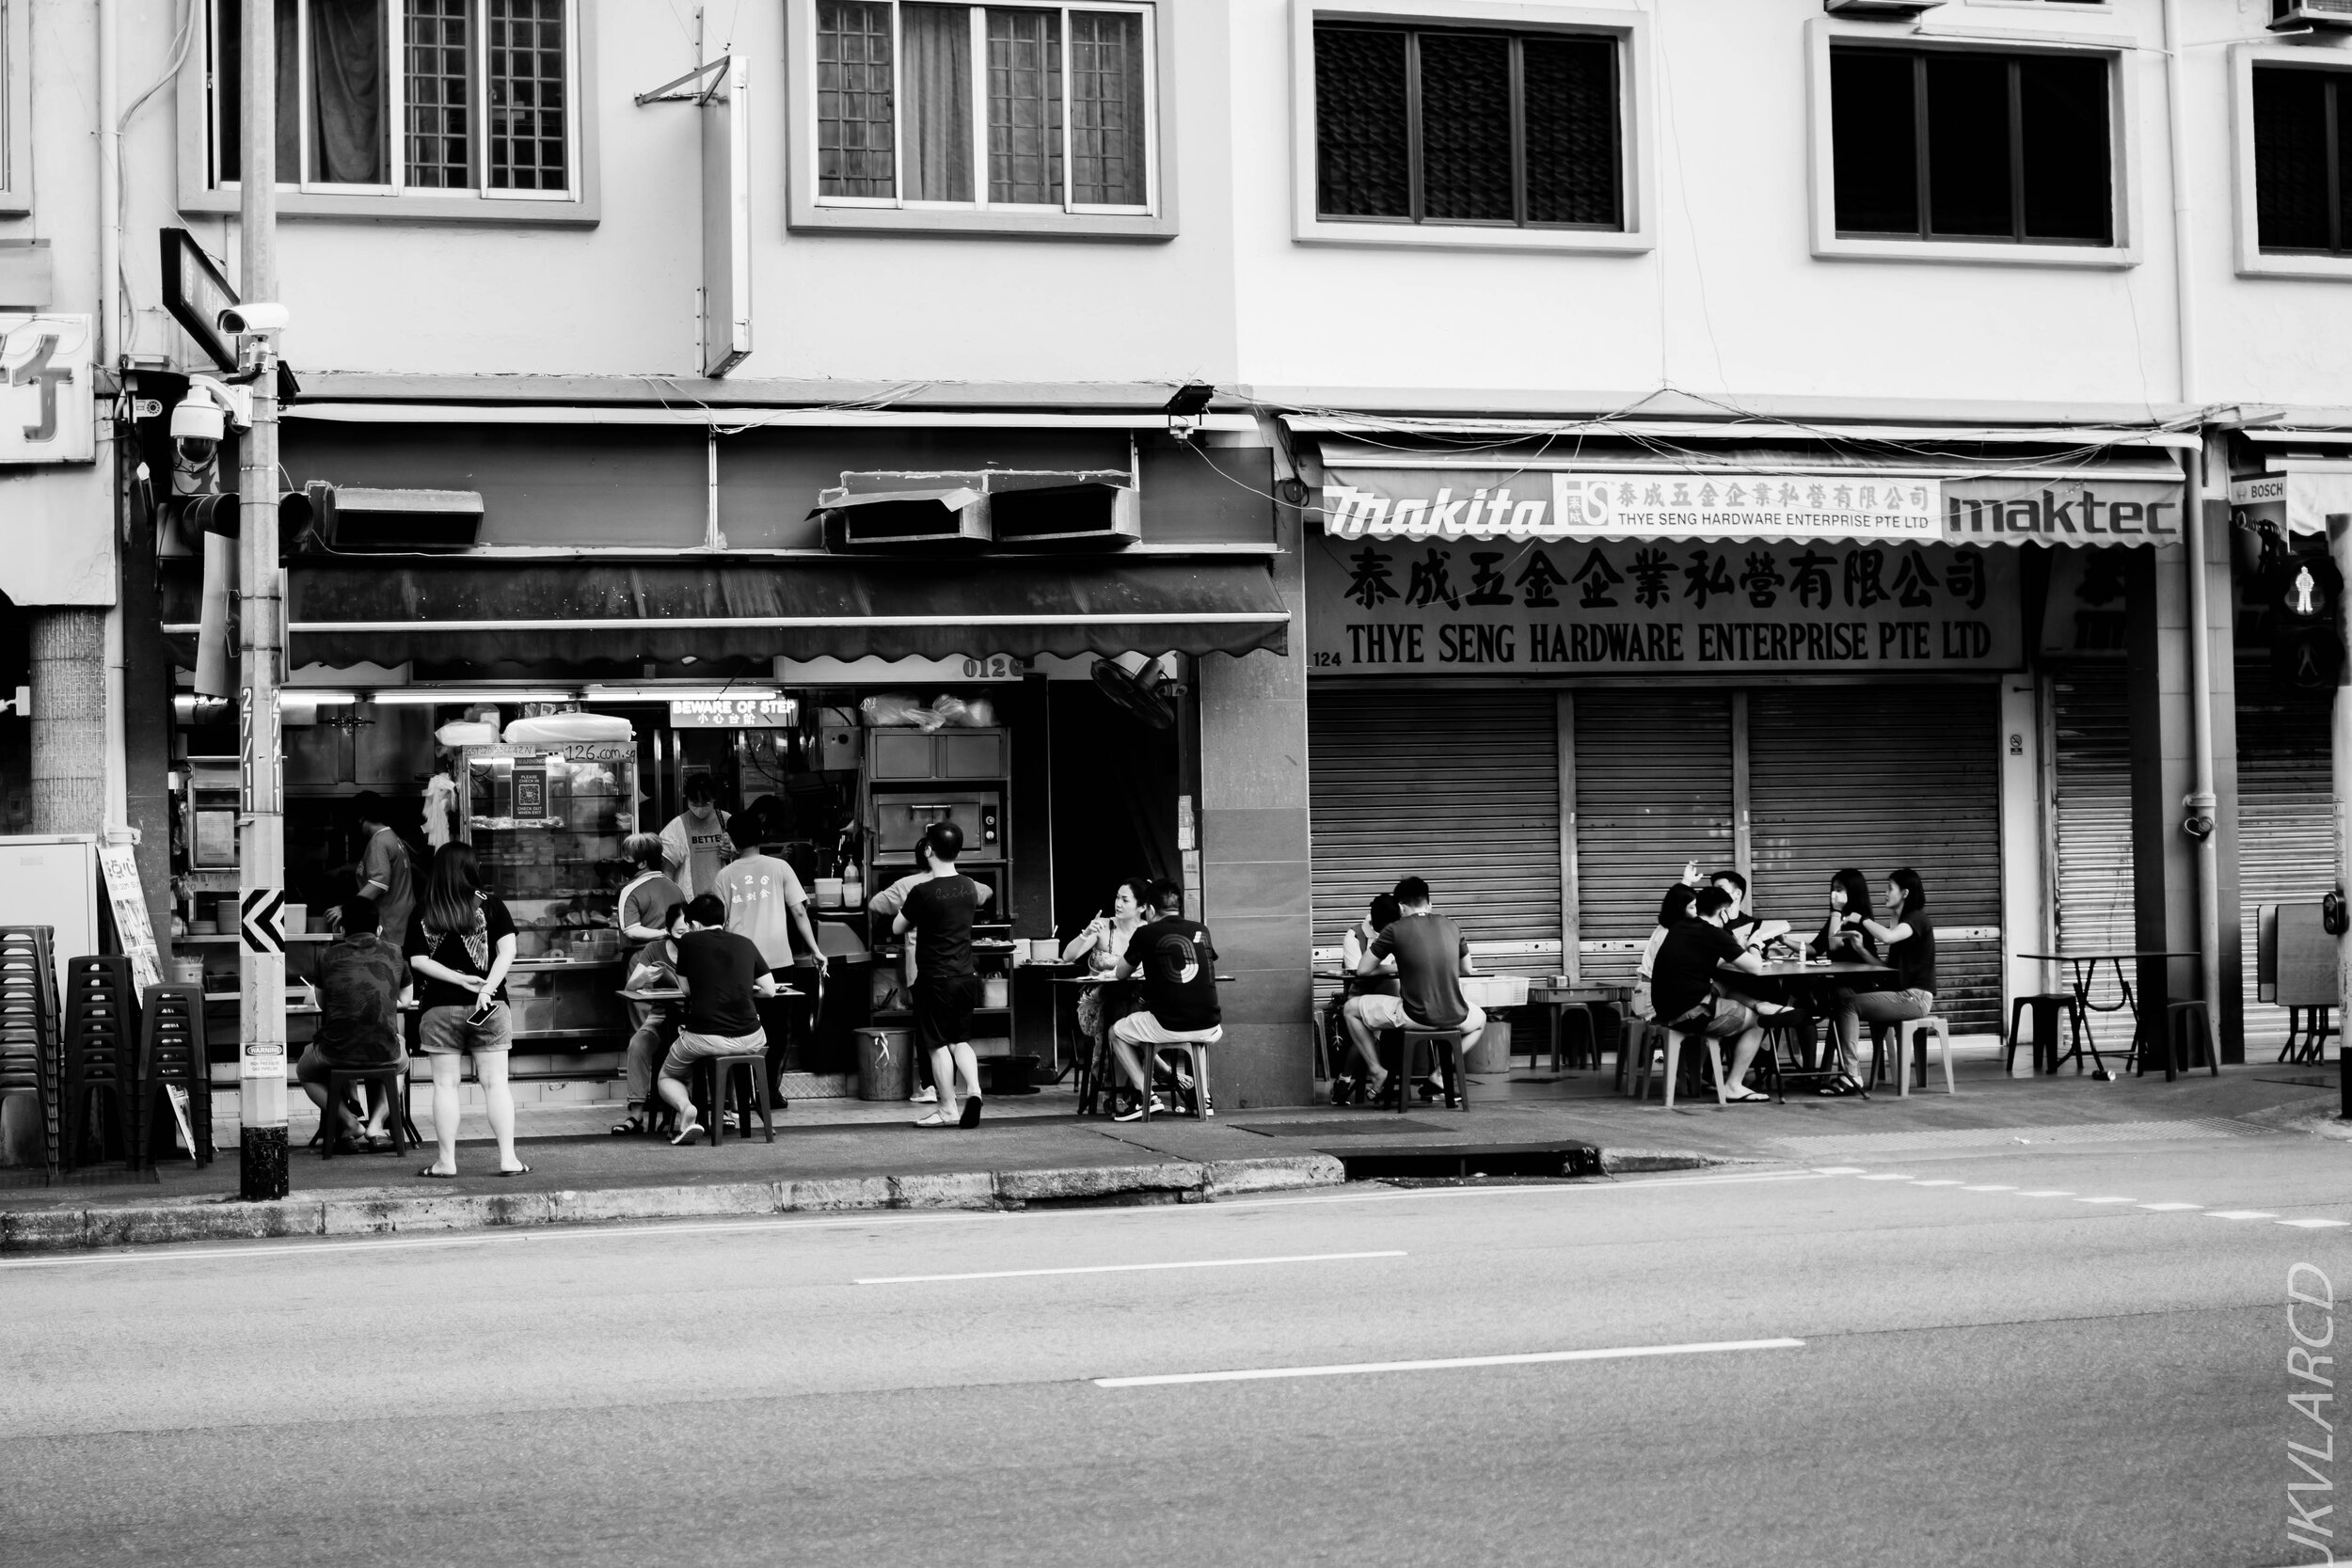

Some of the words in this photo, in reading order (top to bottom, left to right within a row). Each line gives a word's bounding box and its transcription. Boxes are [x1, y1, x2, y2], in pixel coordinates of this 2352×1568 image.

[1616, 482, 1930, 512] 泰成五金企業私營有限公司
[2250, 483, 2283, 499] BOSCH
[1948, 488, 2177, 535] maktec
[1618, 513, 1654, 525] THYE
[1659, 513, 1697, 526] SENG
[1702, 513, 1782, 526] HARDWARE
[1788, 514, 1870, 528] ENTERPRISE
[1876, 515, 1900, 529] PTE
[1905, 516, 1929, 530] LTD
[1343, 546, 1987, 611] 泰成五金企業私營有限公司
[1346, 624, 1424, 664] THYE
[1438, 624, 1516, 664] SENG
[1529, 623, 1684, 663] HARDWARE
[1697, 622, 1868, 662] ENTERPRISE
[1878, 621, 1931, 659] PTE
[1942, 621, 1992, 659] LTD
[1313, 652, 1343, 667] 124
[672, 700, 733, 715] BEWARE
[737, 700, 756, 714] OF
[760, 699, 796, 714] STEP
[564, 744, 637, 765] 126.com.sg
[691, 834, 723, 844] BETTE
